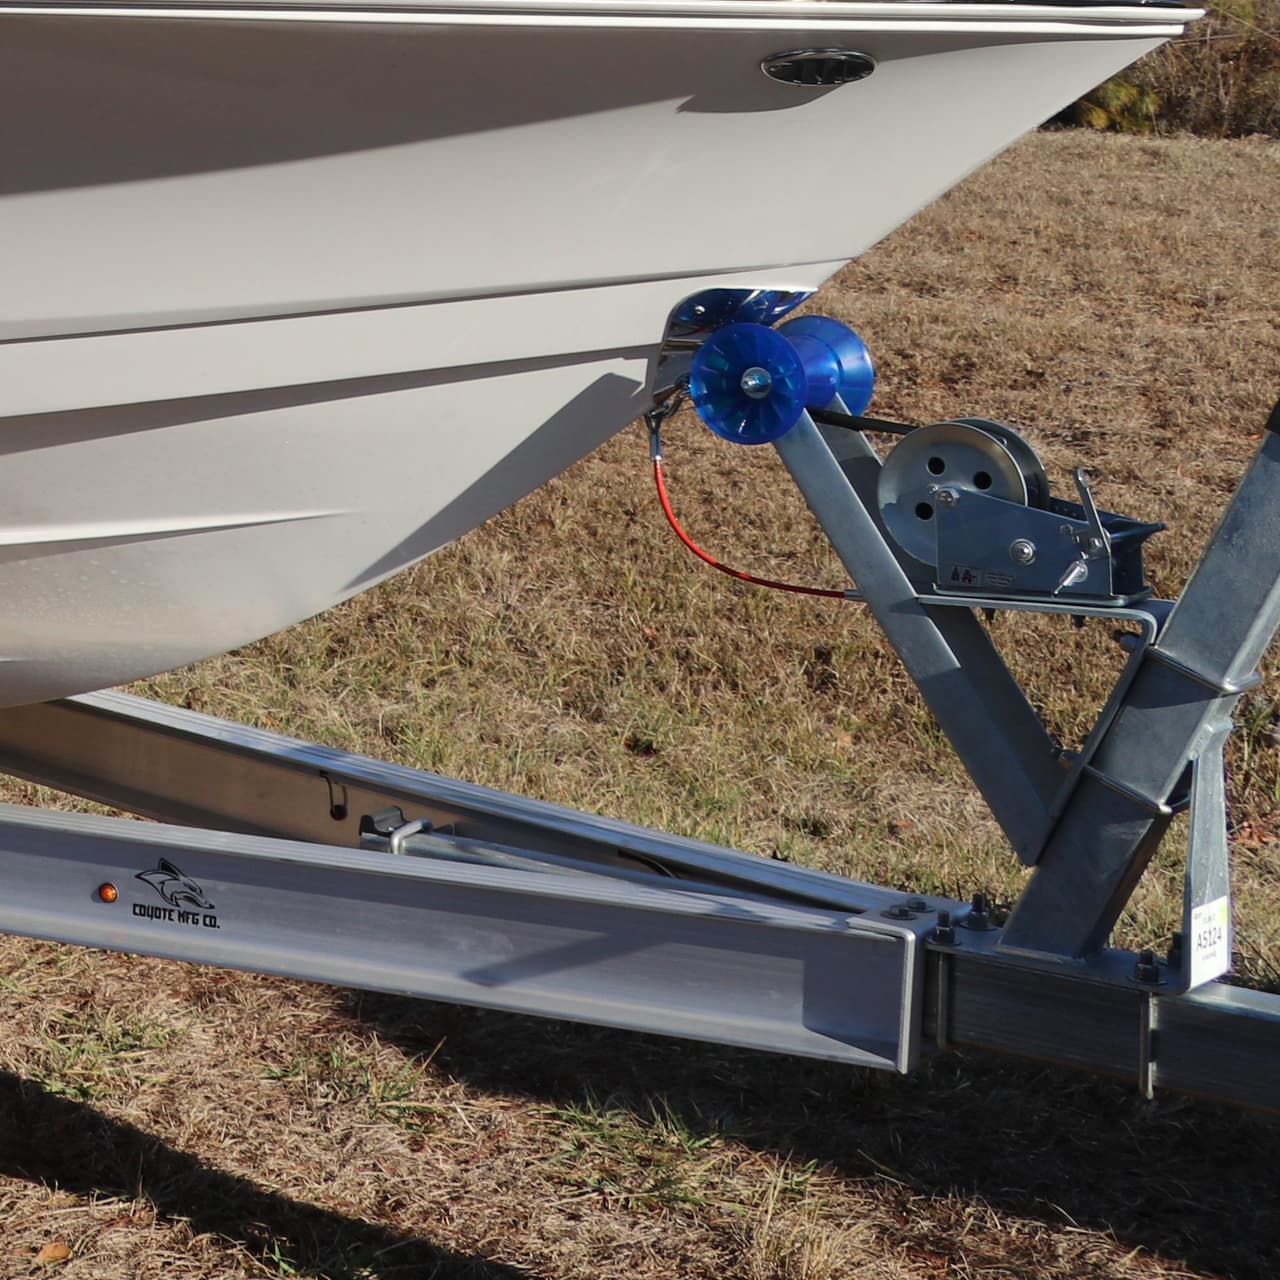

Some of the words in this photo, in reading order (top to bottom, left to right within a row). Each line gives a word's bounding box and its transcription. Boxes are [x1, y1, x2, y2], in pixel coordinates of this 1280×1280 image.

[132, 903, 175, 921] COYOTE
[177, 910, 200, 926] MFG
[202, 914, 221, 929] CO.
